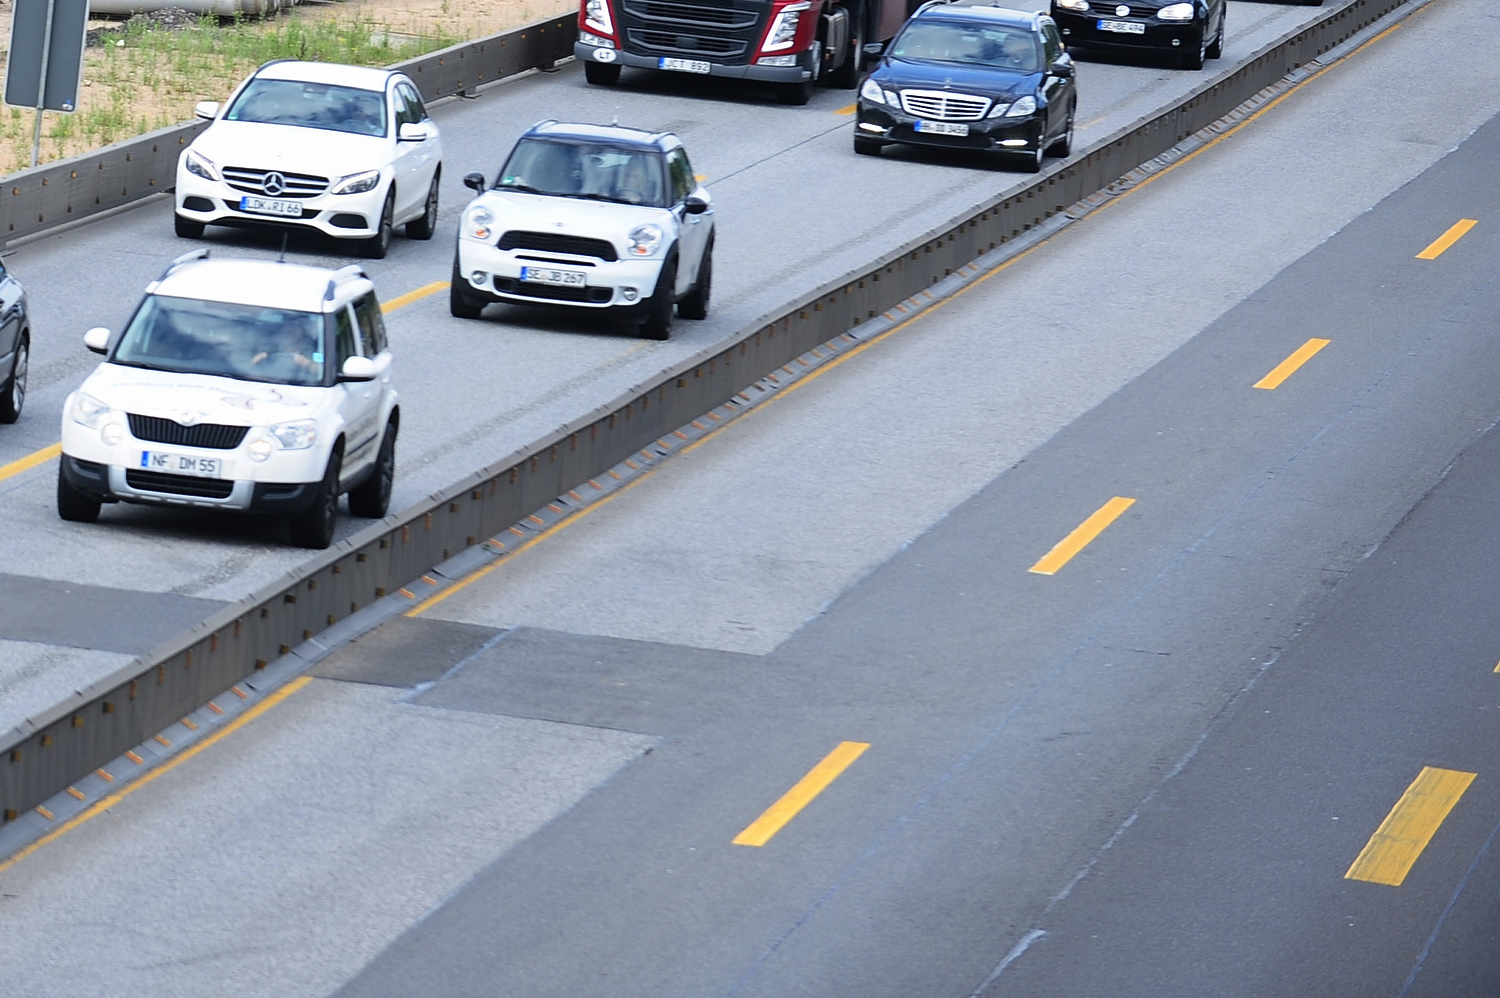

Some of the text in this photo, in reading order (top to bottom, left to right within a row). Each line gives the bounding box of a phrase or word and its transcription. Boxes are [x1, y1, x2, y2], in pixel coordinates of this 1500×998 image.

[600, 52, 610, 60] LT
[247, 198, 300, 214] LDK RI 66
[527, 268, 541, 280] SE
[564, 272, 584, 284] 267
[152, 454, 216, 473] NF DM 55
